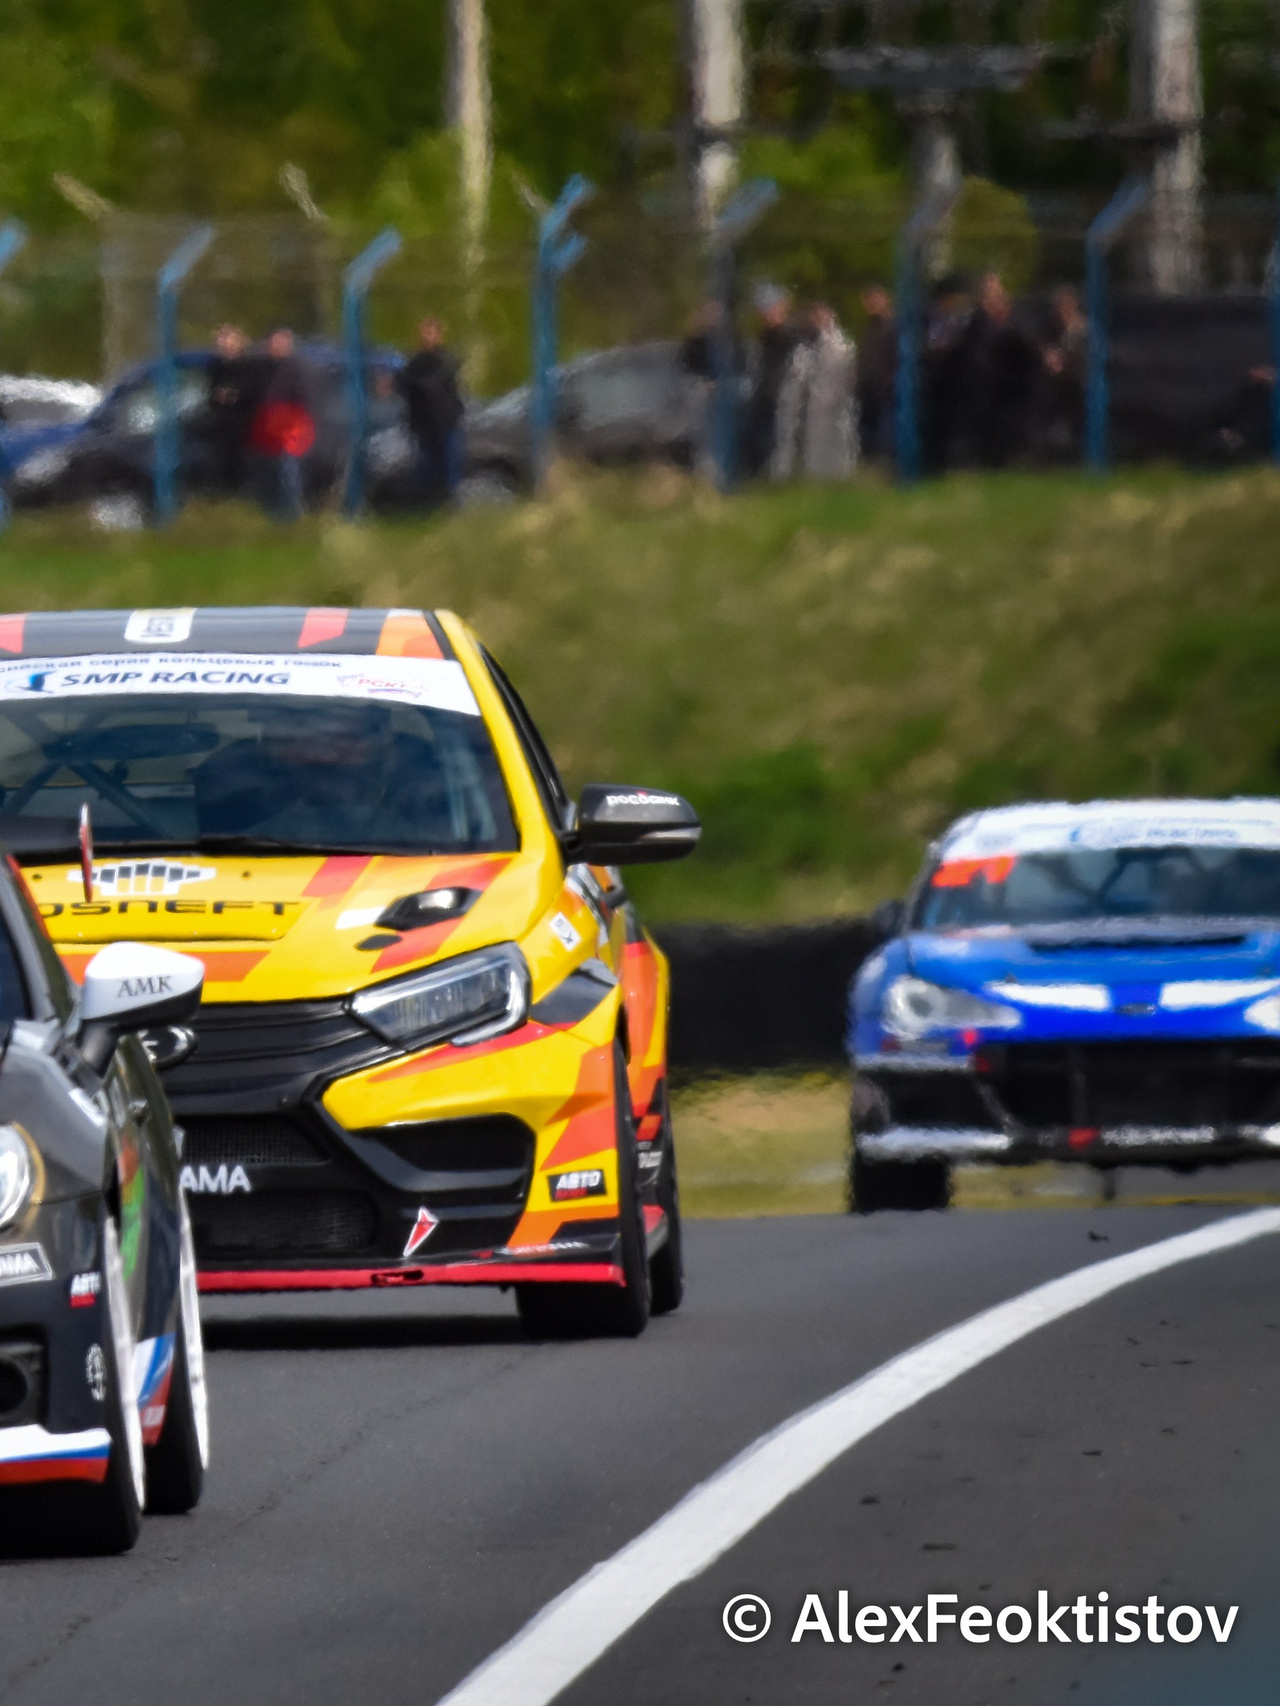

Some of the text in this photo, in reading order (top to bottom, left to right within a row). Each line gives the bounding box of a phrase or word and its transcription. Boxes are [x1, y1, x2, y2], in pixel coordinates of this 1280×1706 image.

[60, 670, 290, 687] SMP RACING
[35, 899, 301, 919] OSNEFT
